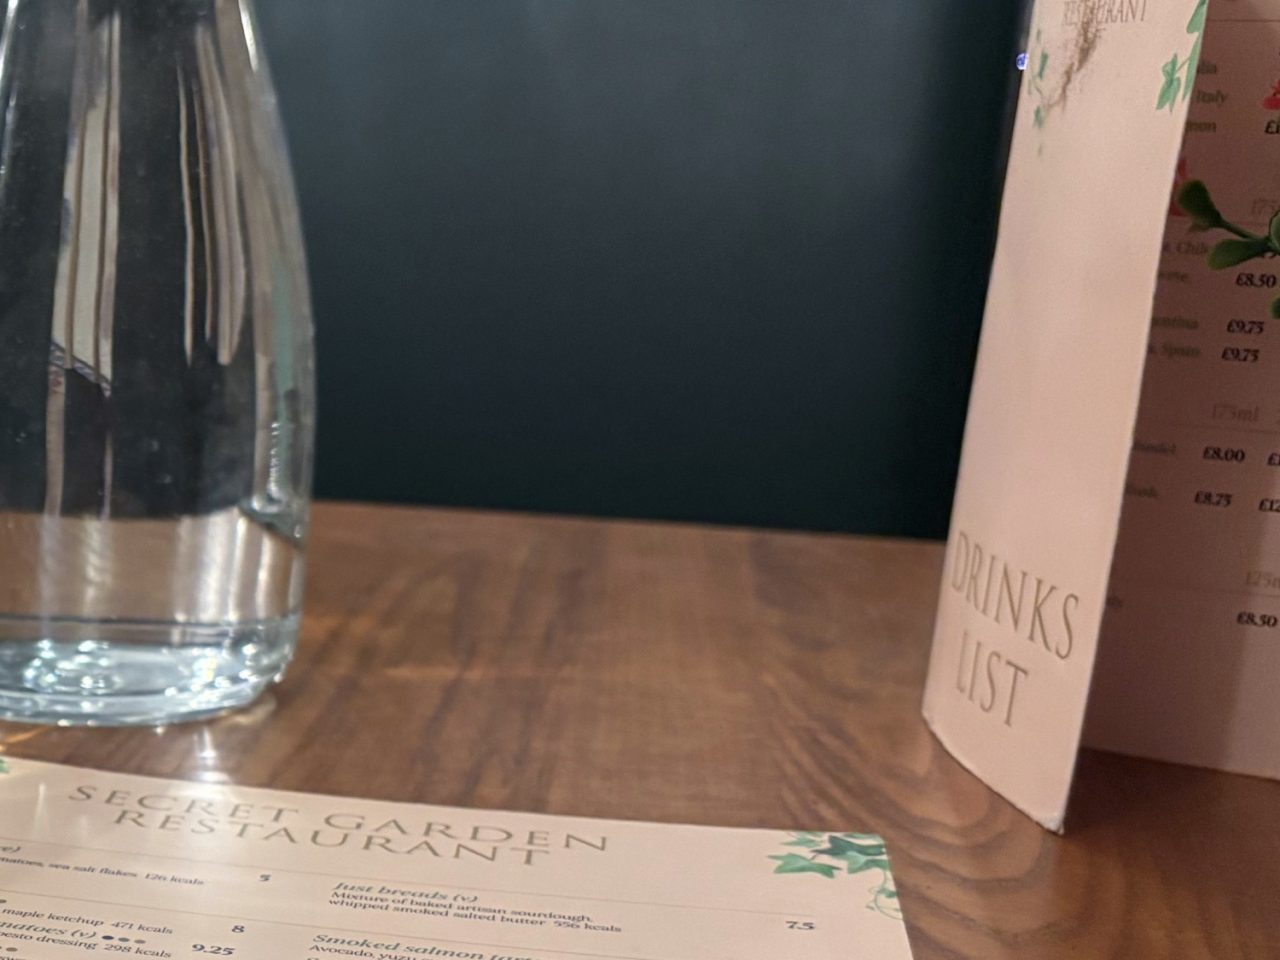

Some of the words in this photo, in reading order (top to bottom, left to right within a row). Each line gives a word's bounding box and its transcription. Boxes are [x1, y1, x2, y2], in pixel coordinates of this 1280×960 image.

[1235, 271, 1277, 289] £8.50
[1226, 318, 1265, 335] £9.75
[1221, 346, 1260, 363] £9.75
[1202, 445, 1246, 464] £8.00
[951, 531, 1079, 661] DRINKS
[1236, 611, 1278, 629] £8.50
[955, 628, 1029, 728] LIST
[66, 784, 299, 823] SECRET
[322, 813, 607, 852] GARDEN
[112, 808, 550, 866] RESTAURANT
[376, 885, 448, 900] breads
[451, 893, 478, 903] (v)
[69, 928, 97, 939] (v)
[230, 924, 245, 933] 8
[784, 919, 815, 931] 7.5
[190, 942, 236, 956] 9.25
[311, 933, 401, 951] Smoked
[402, 945, 484, 960] salmon
